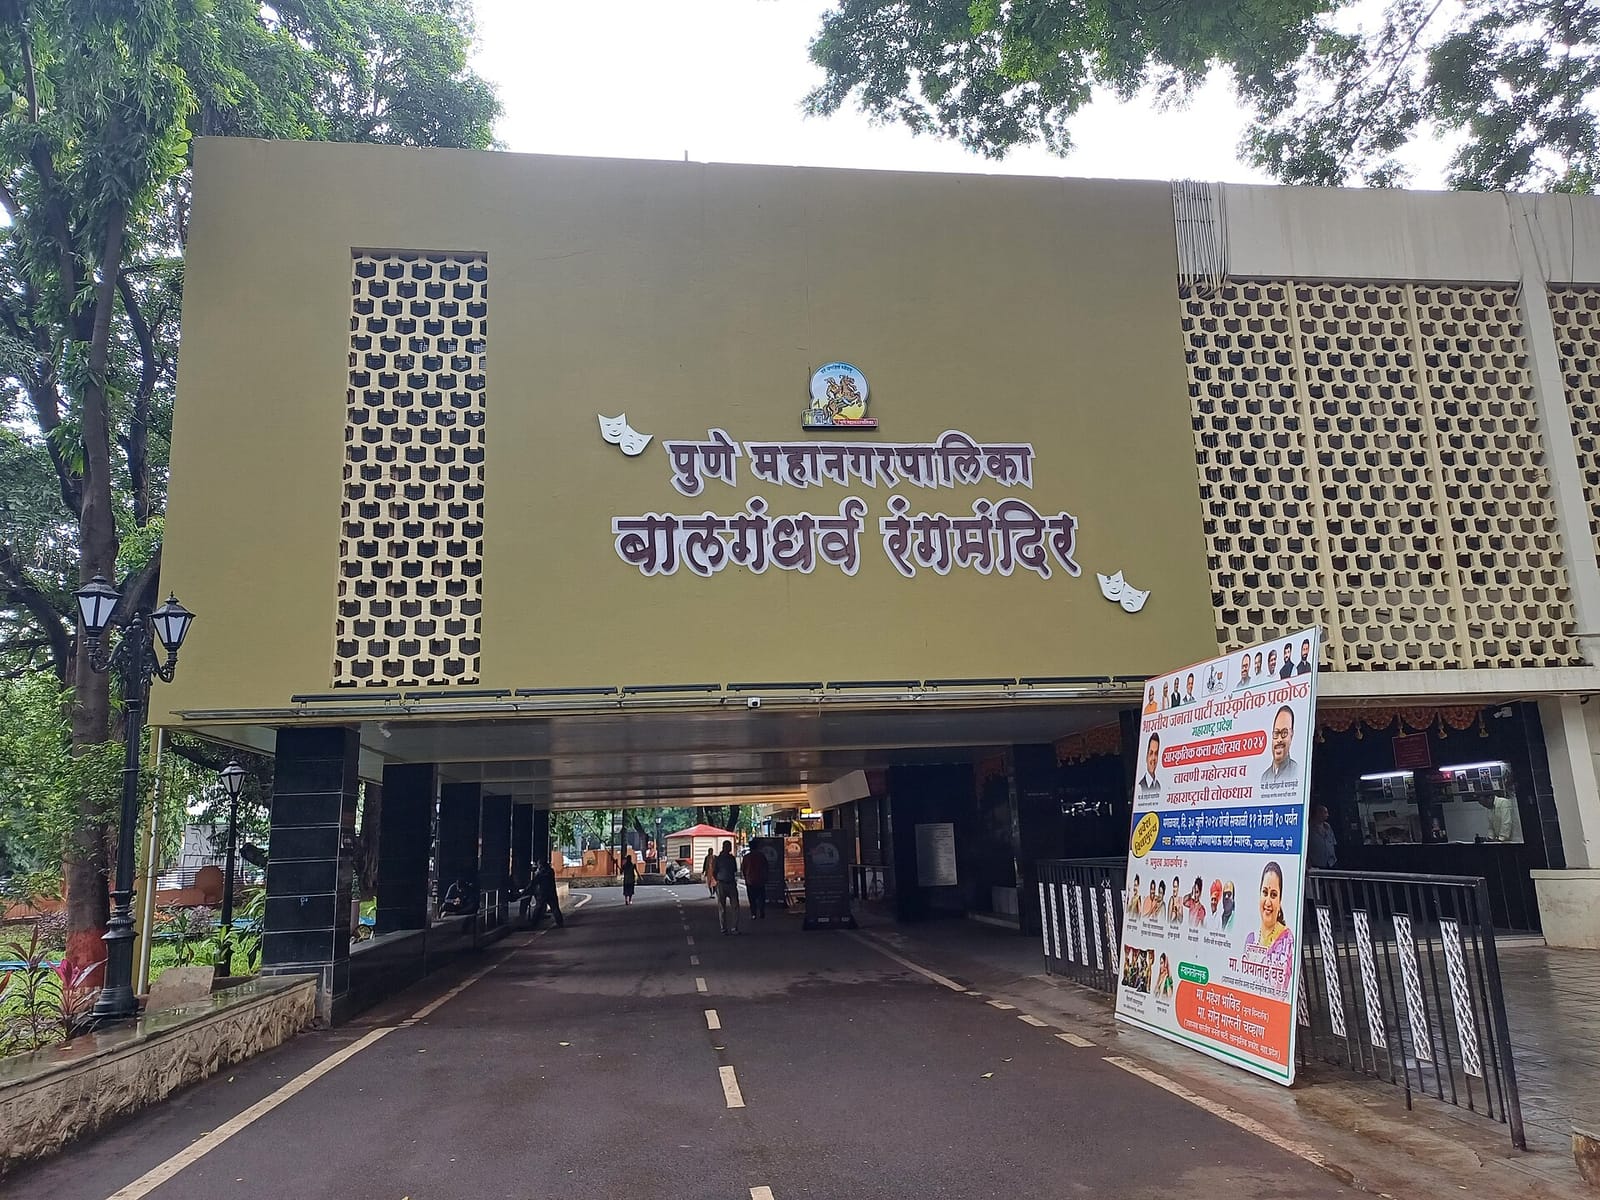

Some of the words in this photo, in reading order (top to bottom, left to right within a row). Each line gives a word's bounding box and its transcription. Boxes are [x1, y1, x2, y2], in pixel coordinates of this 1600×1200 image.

[664, 429, 741, 496] पुणे
[745, 431, 1033, 488] महानगरपालिका
[612, 496, 867, 575] बालगंधर्व
[880, 496, 1080, 576] रंगमंदिर
[1142, 714, 1168, 732] भारतीय
[1169, 711, 1193, 726] जनता
[1194, 699, 1213, 721] पार्टी
[1267, 681, 1309, 706] प्रकोष्ठ
[1191, 724, 1215, 737] महाराष्ट्र
[1216, 717, 1233, 733] प्रदेश
[1164, 744, 1195, 765] सांस्कृतिक
[1196, 746, 1211, 758] कला
[1212, 739, 1241, 756] महोत्सव
[1242, 739, 1264, 751] २०२४
[1174, 767, 1200, 784] लावणी
[1201, 765, 1239, 780] महोत्सव
[1239, 765, 1247, 777] व
[1167, 789, 1210, 807] महाराष्ट्राची
[1211, 785, 1253, 801] लोकधारा
[1188, 817, 1195, 830] ३०
[1205, 816, 1219, 828] २०२४
[1249, 814, 1256, 828] ११
[1257, 810, 1262, 826] ते
[1229, 957, 1239, 972] मा.
[1196, 988, 1204, 1001] मा.
[1206, 988, 1220, 1006] महेश
